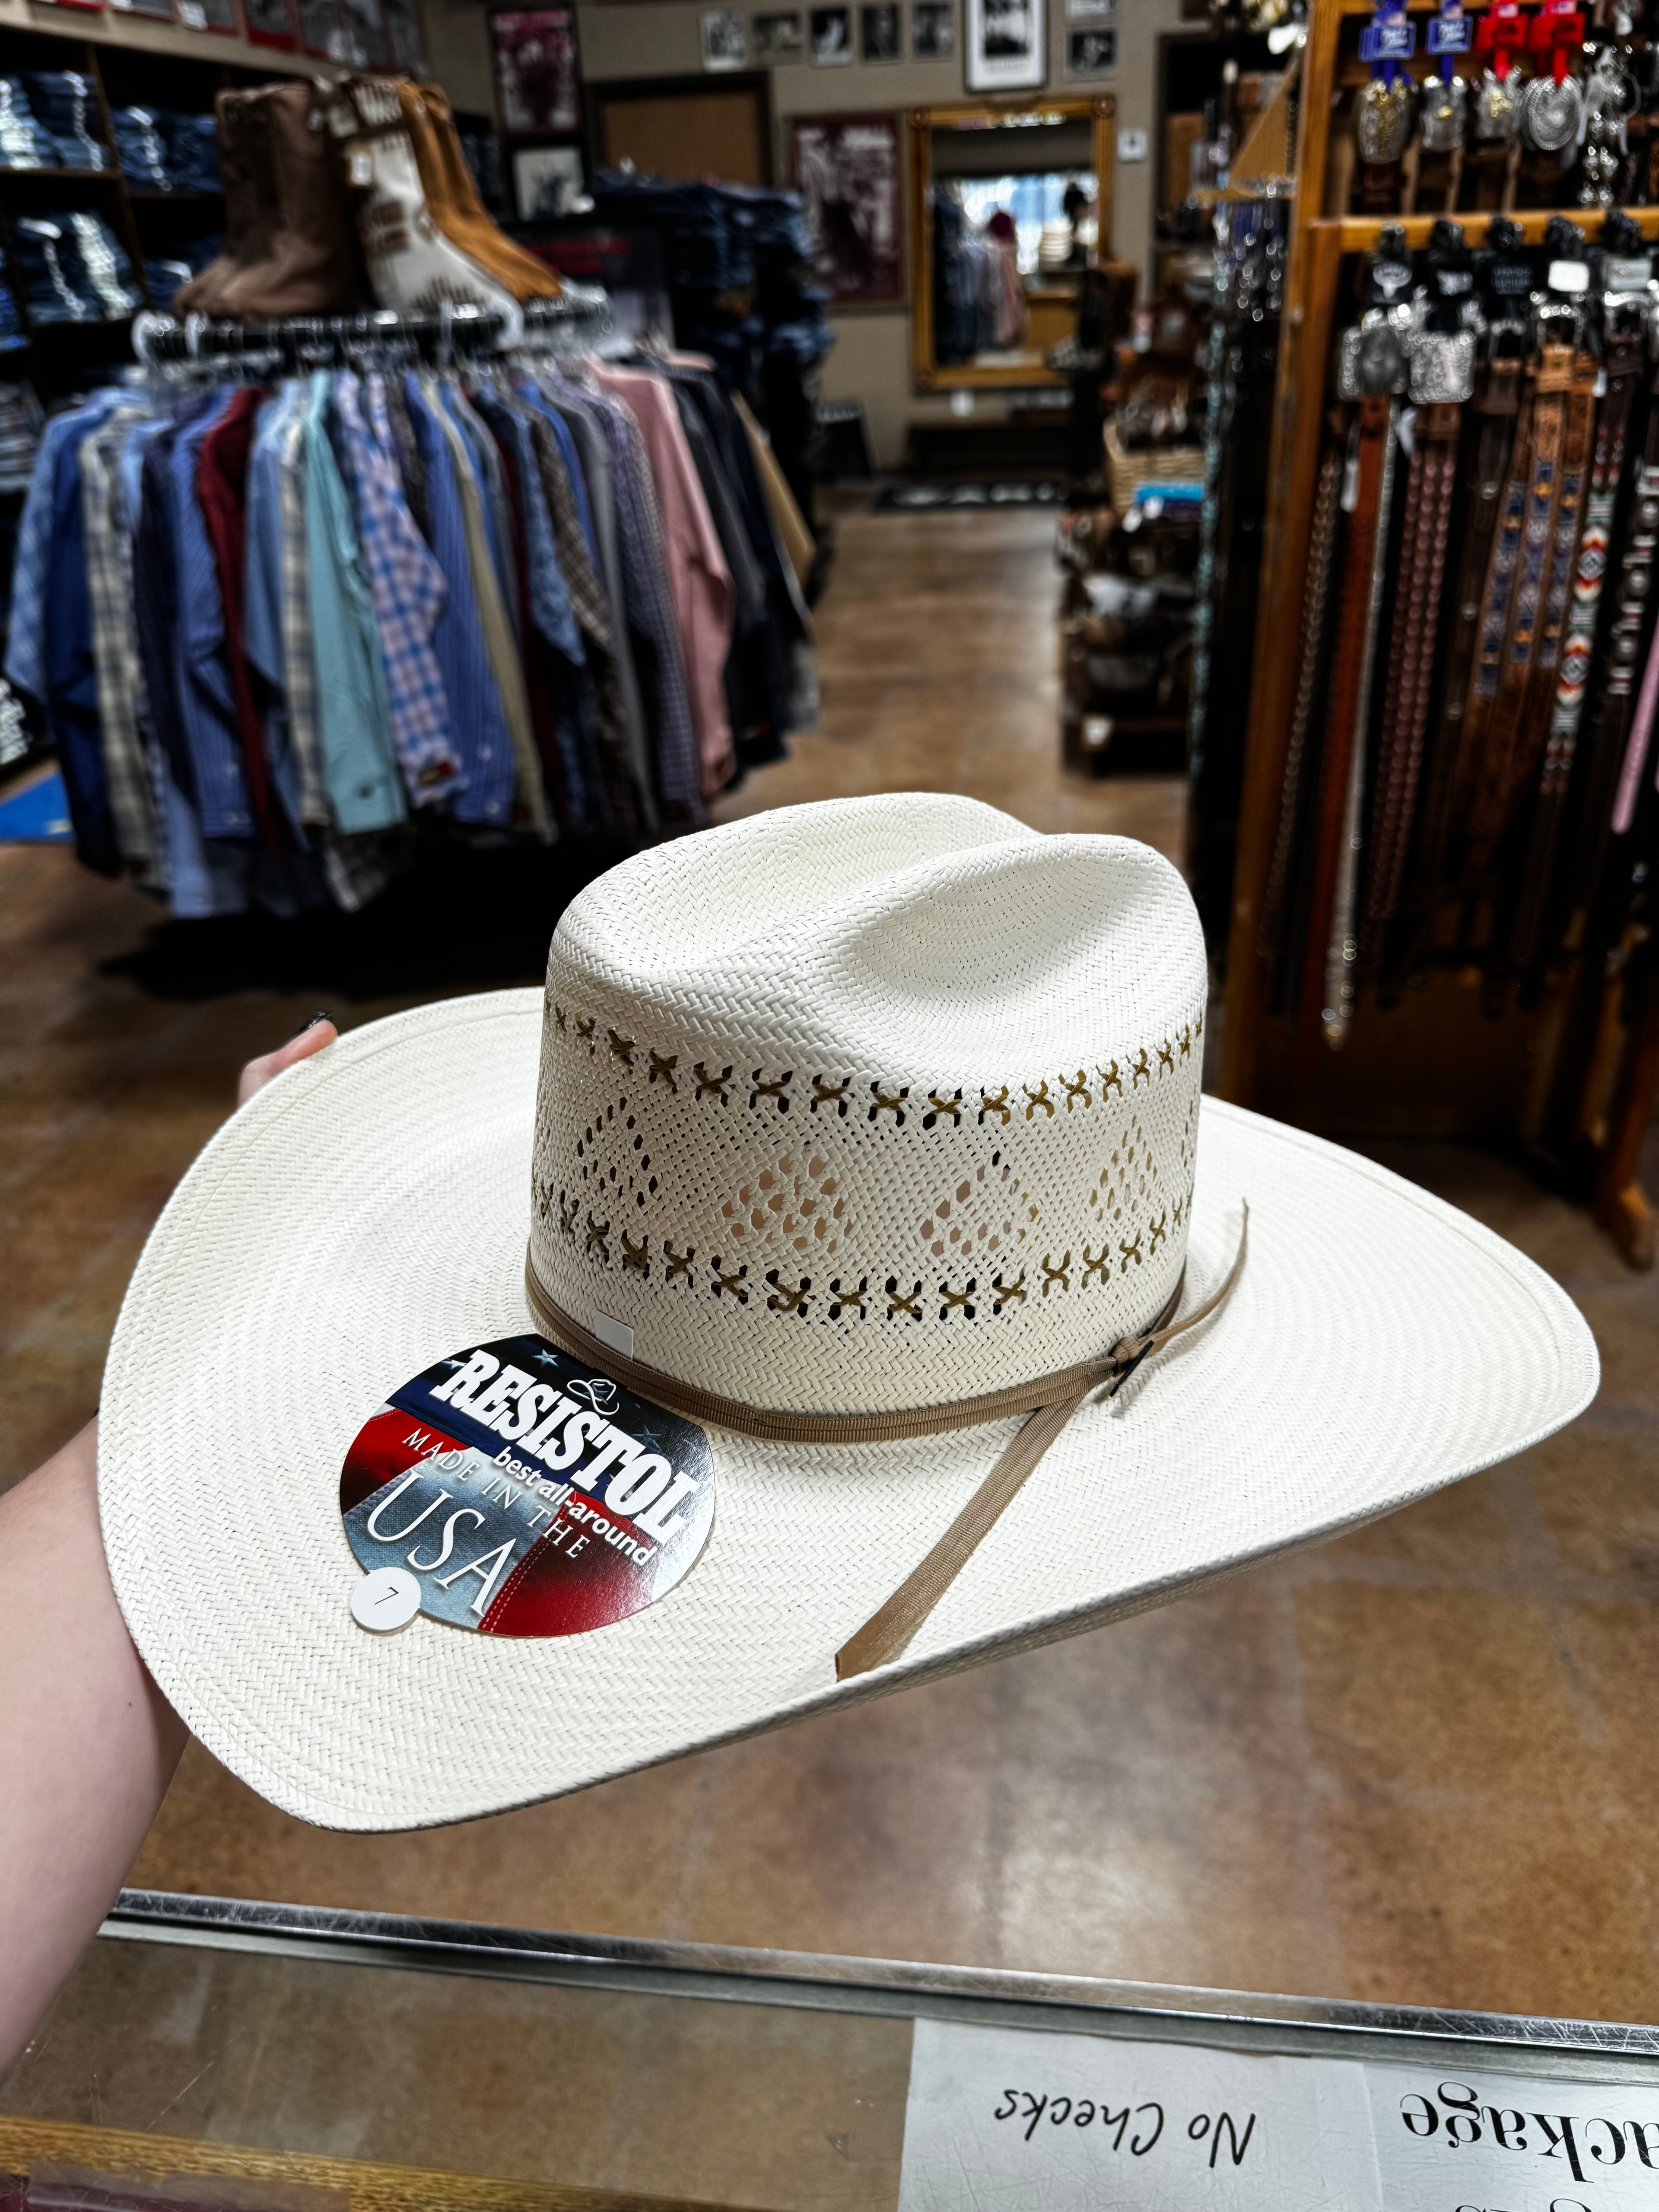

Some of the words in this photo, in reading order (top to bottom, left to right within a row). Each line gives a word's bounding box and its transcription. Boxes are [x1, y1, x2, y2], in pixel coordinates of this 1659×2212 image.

[402, 1428, 480, 1481] MADE
[481, 1477, 523, 1509] IN
[527, 1505, 591, 1558] THE
[429, 1349, 701, 1546] RESISTOL
[367, 1469, 517, 1617] USA
[493, 1446, 542, 1487] best
[539, 1483, 658, 1566] all-around
[374, 1586, 400, 1605] 7
[994, 2089, 1164, 2155] Checks
[1189, 2112, 1256, 2168] No
[1400, 2082, 1659, 2183] ackage
